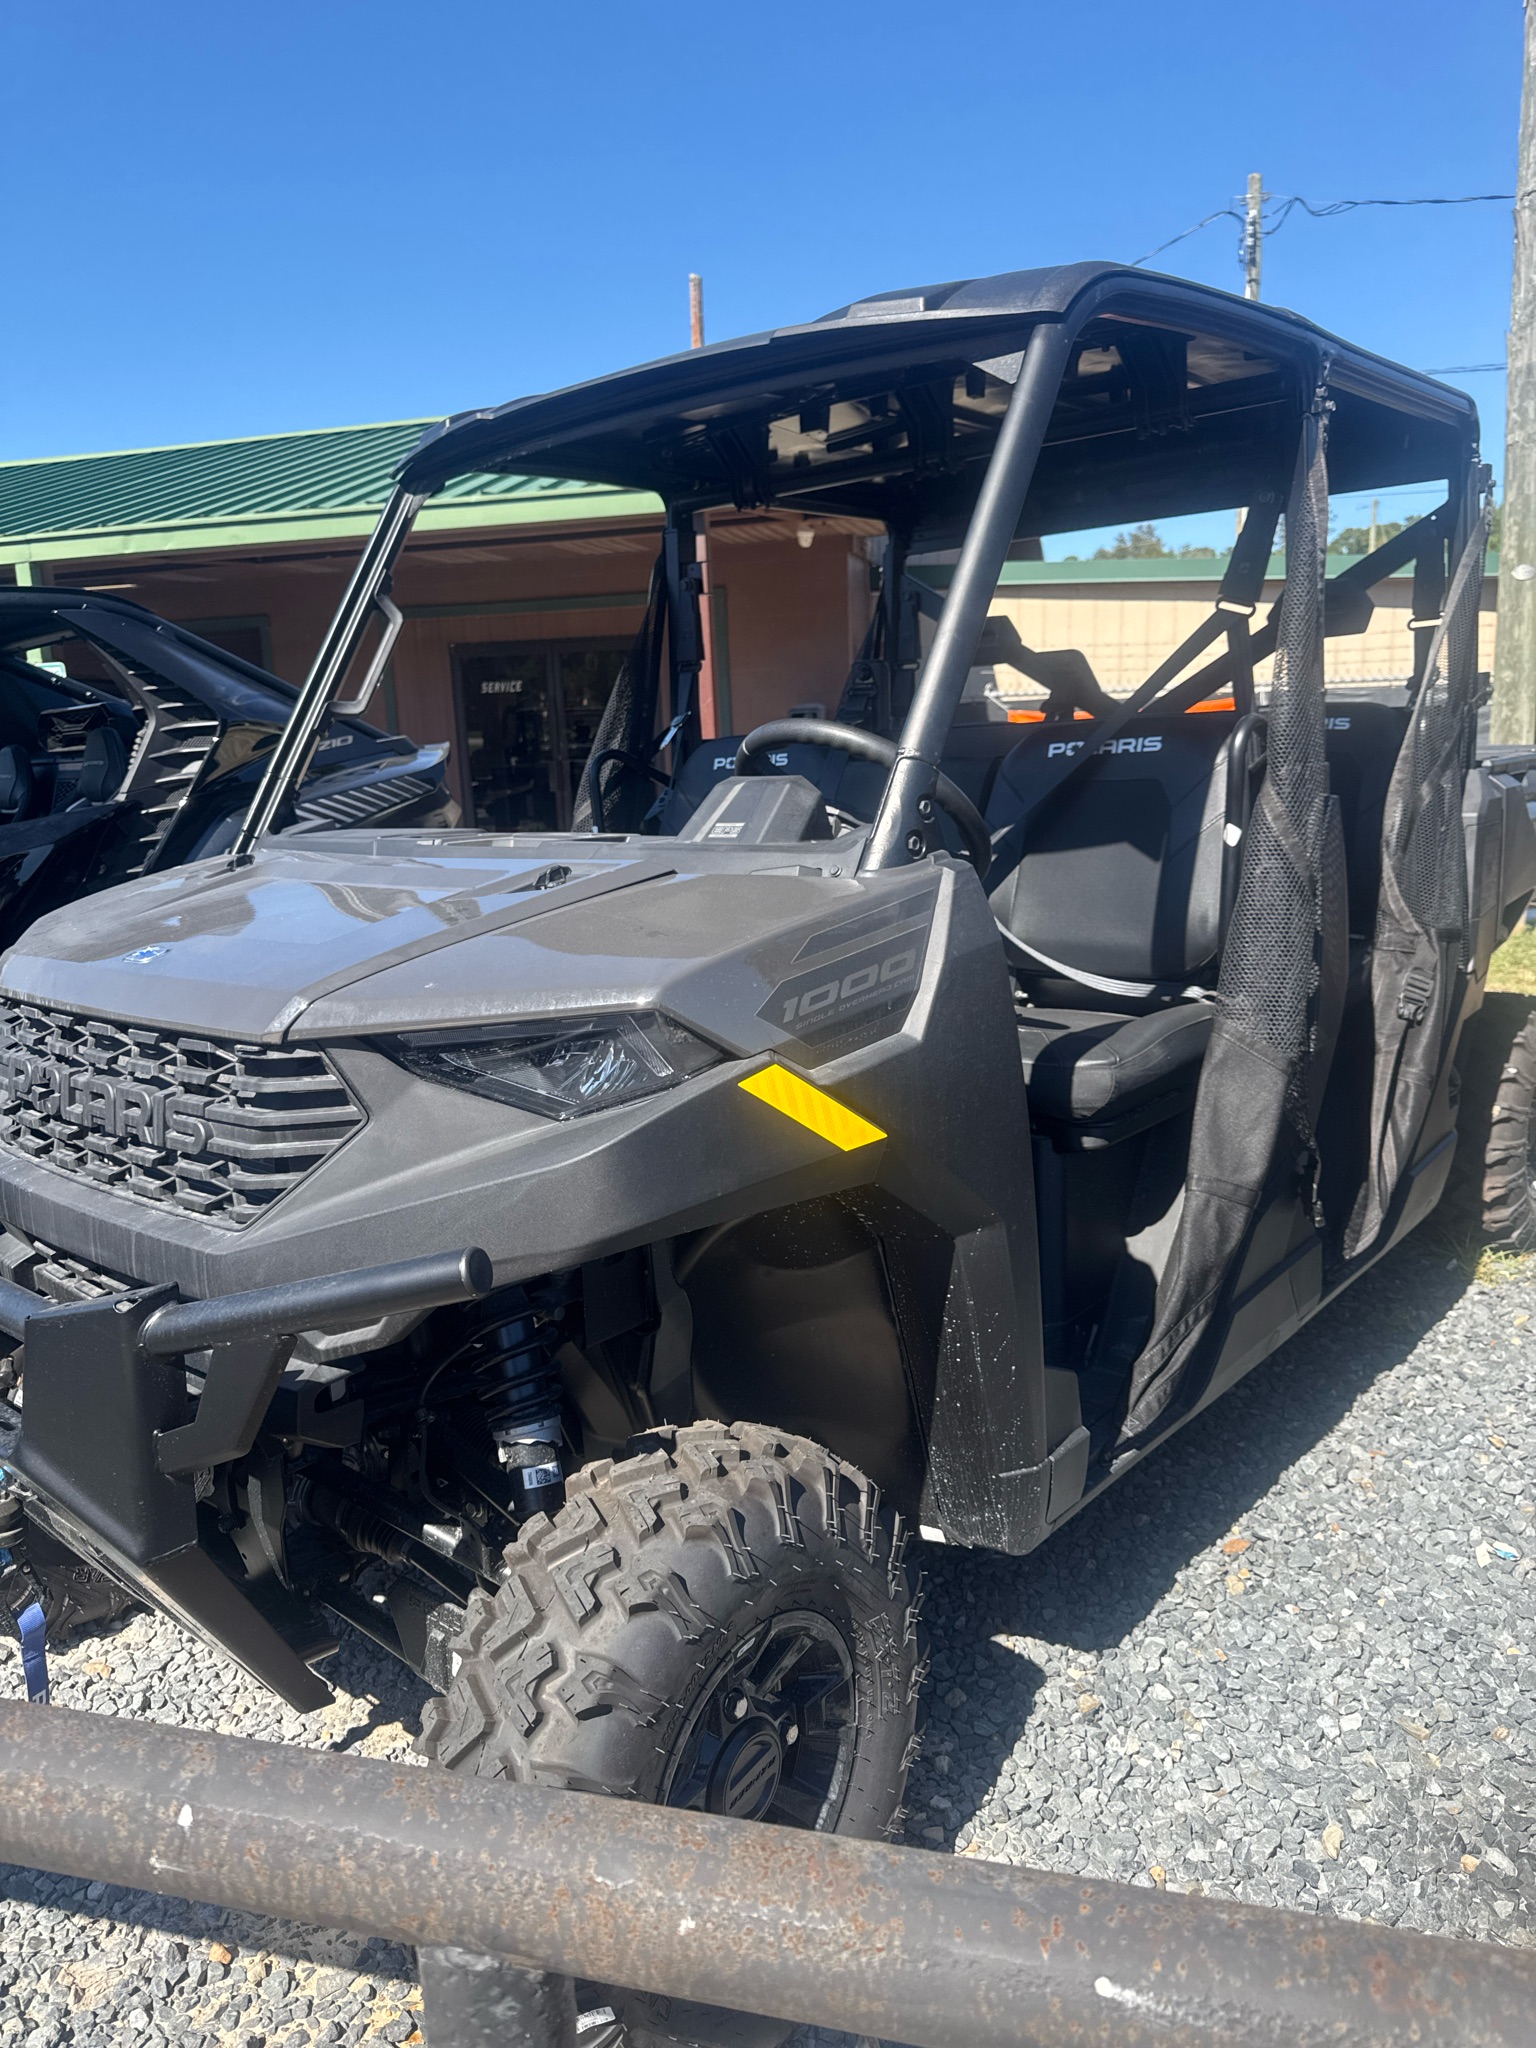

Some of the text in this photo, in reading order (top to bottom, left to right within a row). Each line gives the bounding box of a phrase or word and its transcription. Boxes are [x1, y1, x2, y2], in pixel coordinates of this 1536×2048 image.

[481, 681, 523, 694] SERVICE
[713, 753, 789, 770] POIS
[782, 948, 916, 1024] 1000
[795, 974, 915, 1030] SINGLE OVERHEAD CAM
[6, 1052, 212, 1155] POLARIS
